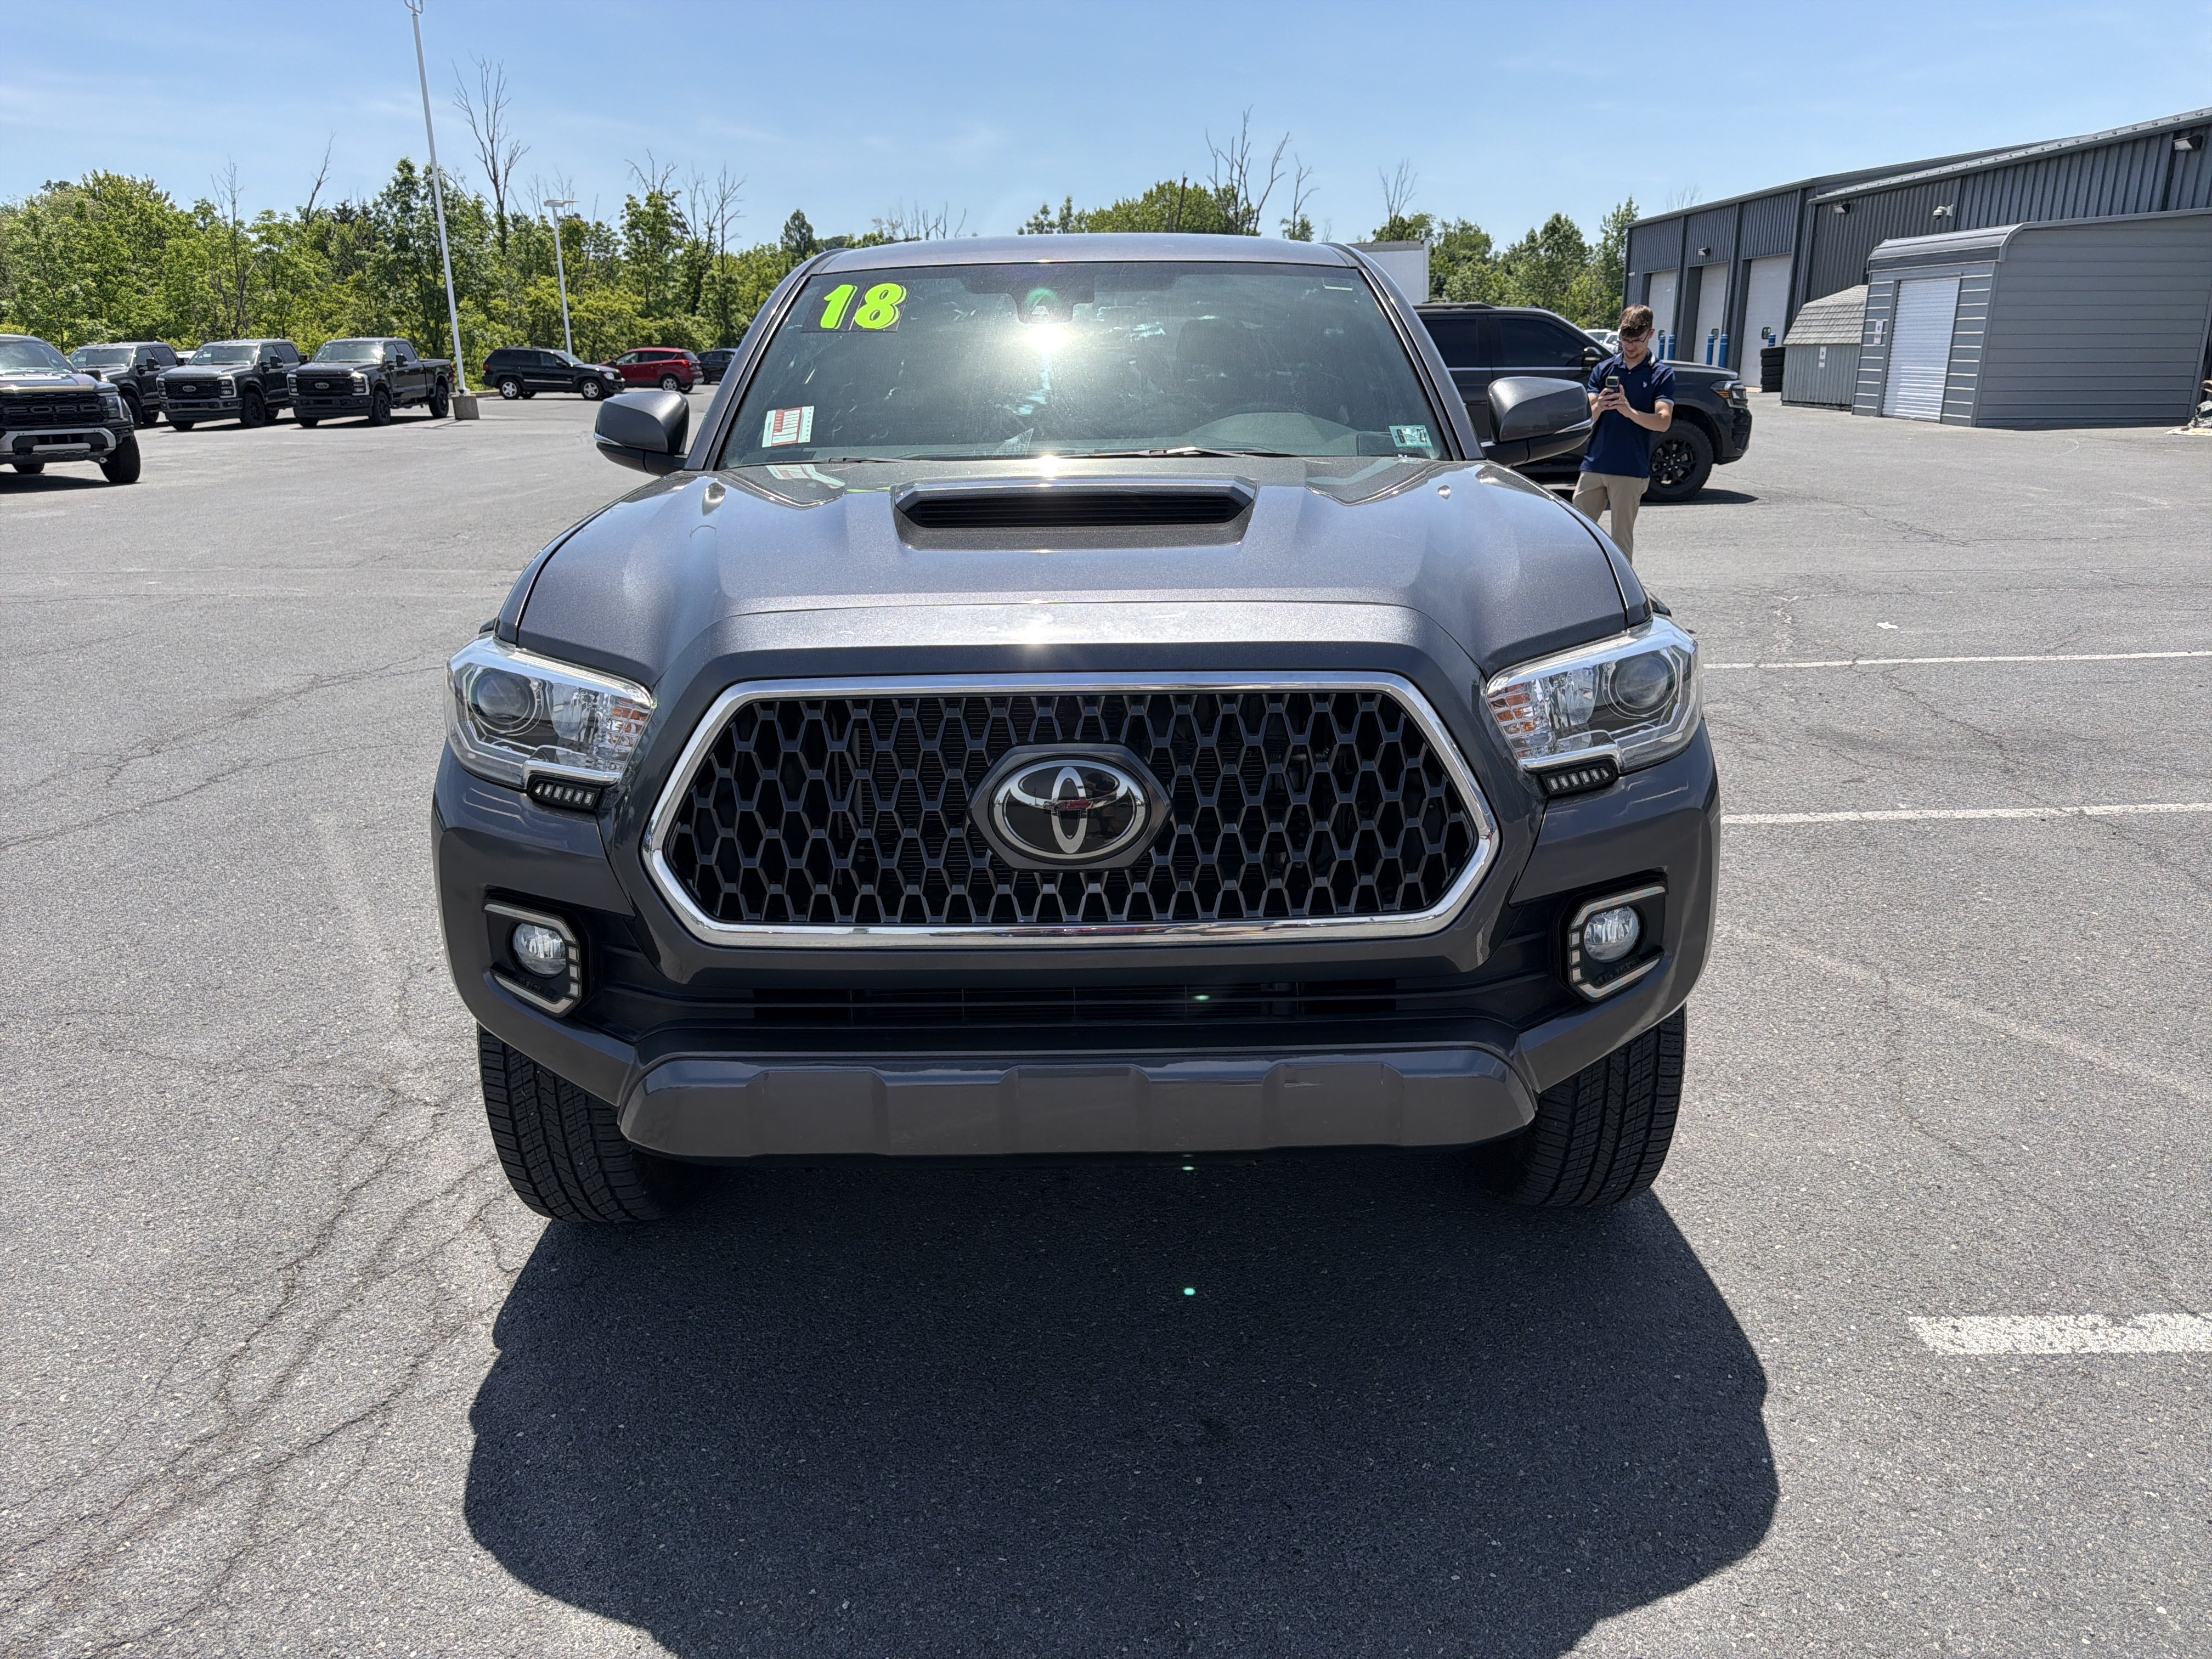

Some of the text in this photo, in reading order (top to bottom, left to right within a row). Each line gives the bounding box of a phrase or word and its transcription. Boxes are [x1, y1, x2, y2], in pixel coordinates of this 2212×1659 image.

[821, 283, 907, 330] 18
[4, 404, 101, 415] FORD
[1397, 429, 1406, 443] 6
